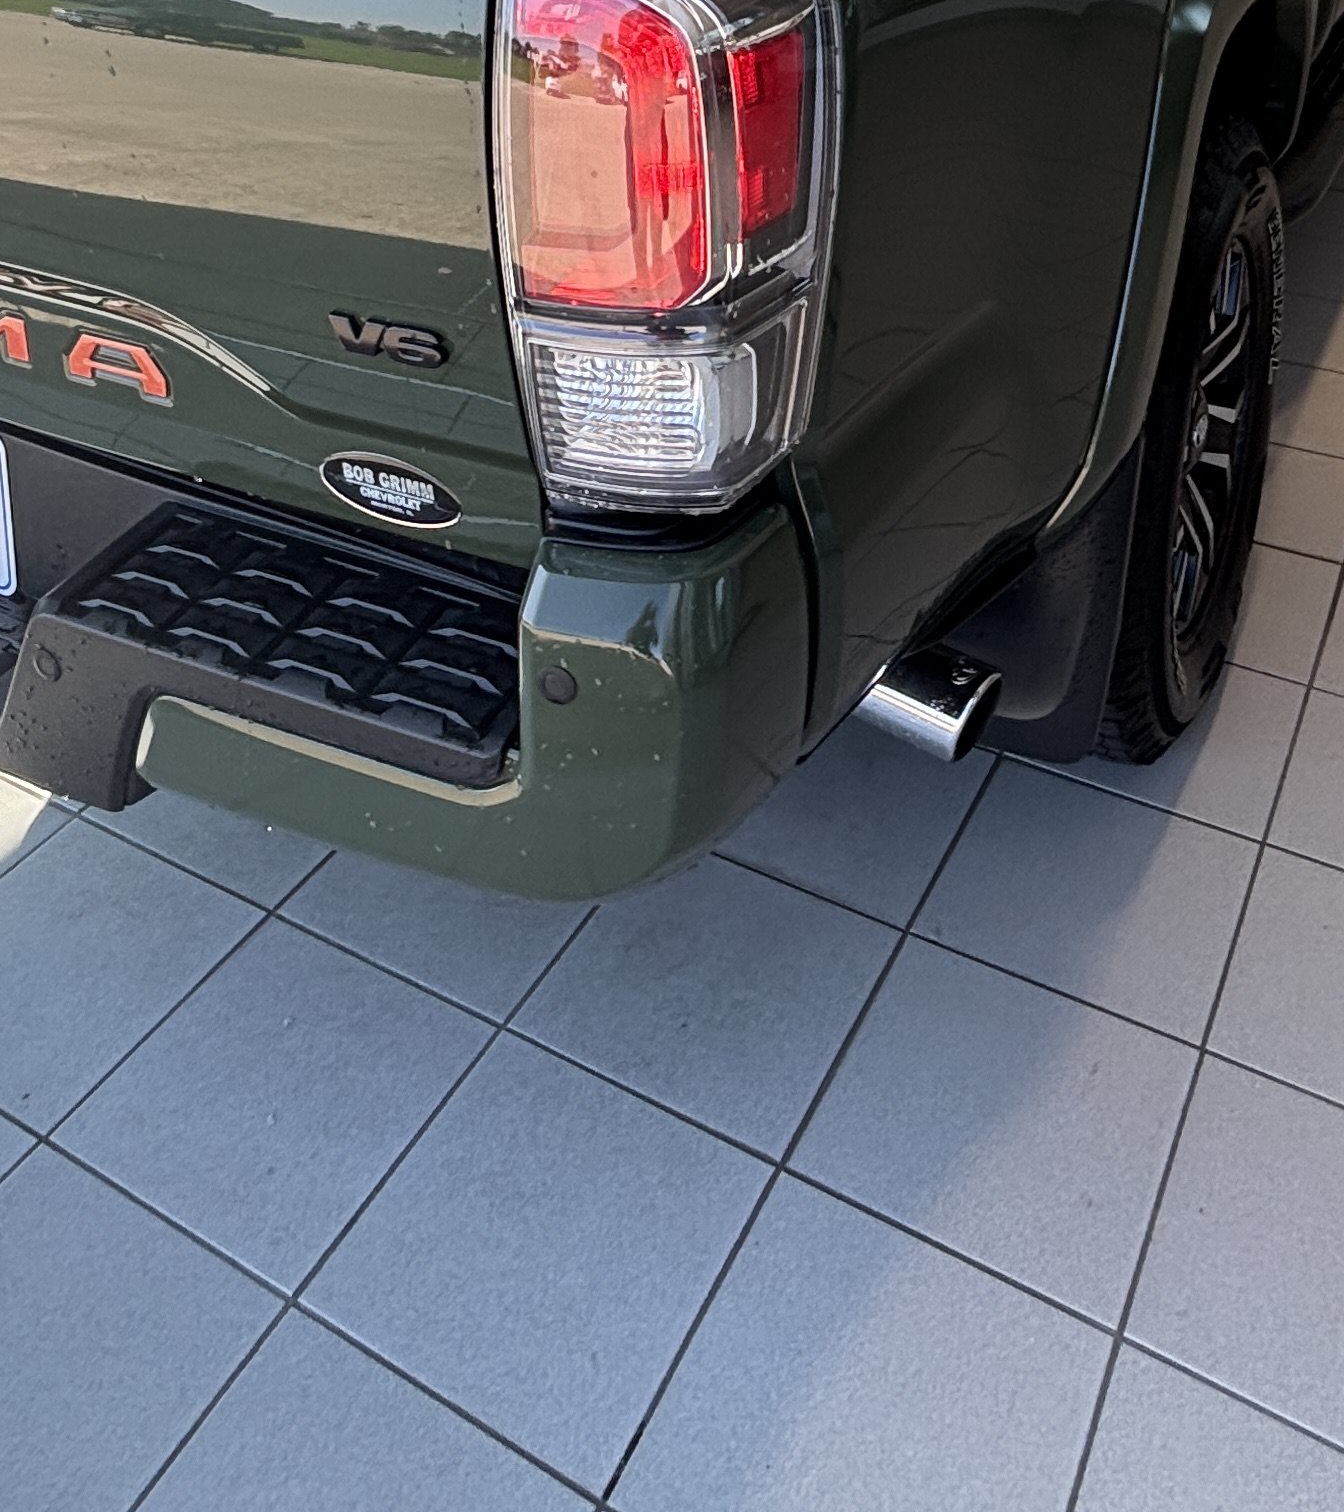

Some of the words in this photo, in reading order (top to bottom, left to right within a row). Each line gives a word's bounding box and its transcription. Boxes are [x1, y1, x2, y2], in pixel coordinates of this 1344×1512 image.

[328, 308, 450, 369] V6
[341, 461, 376, 485] BOB
[378, 472, 436, 501] GRIMM
[359, 486, 422, 512] CHEVROLET
